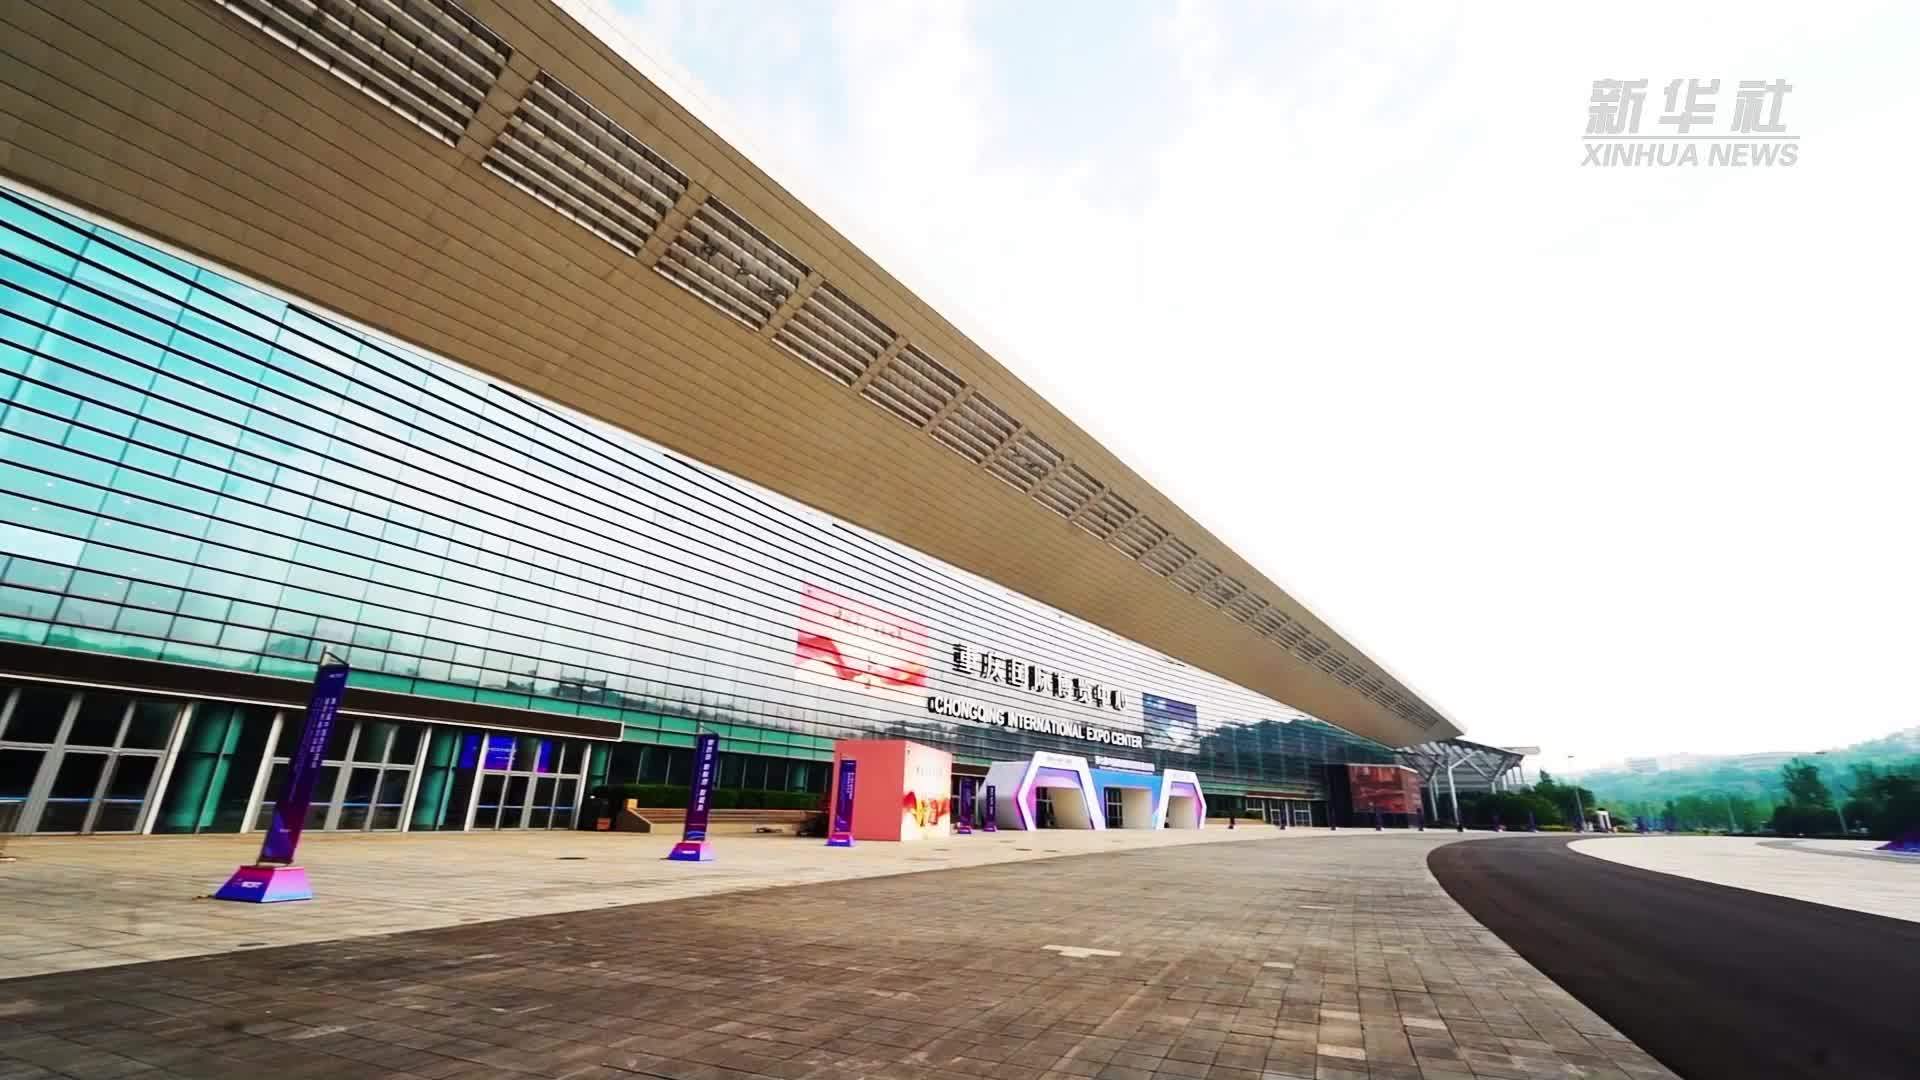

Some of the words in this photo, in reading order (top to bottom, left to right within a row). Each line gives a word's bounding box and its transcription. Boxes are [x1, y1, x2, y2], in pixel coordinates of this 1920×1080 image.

[952, 644, 1127, 711] 重庆国际博览中心
[934, 695, 1005, 725] CHONGQING
[1008, 711, 1084, 739] INTERNATIONAL
[1087, 727, 1109, 743] EXPO
[1111, 732, 1143, 748] CENTER
